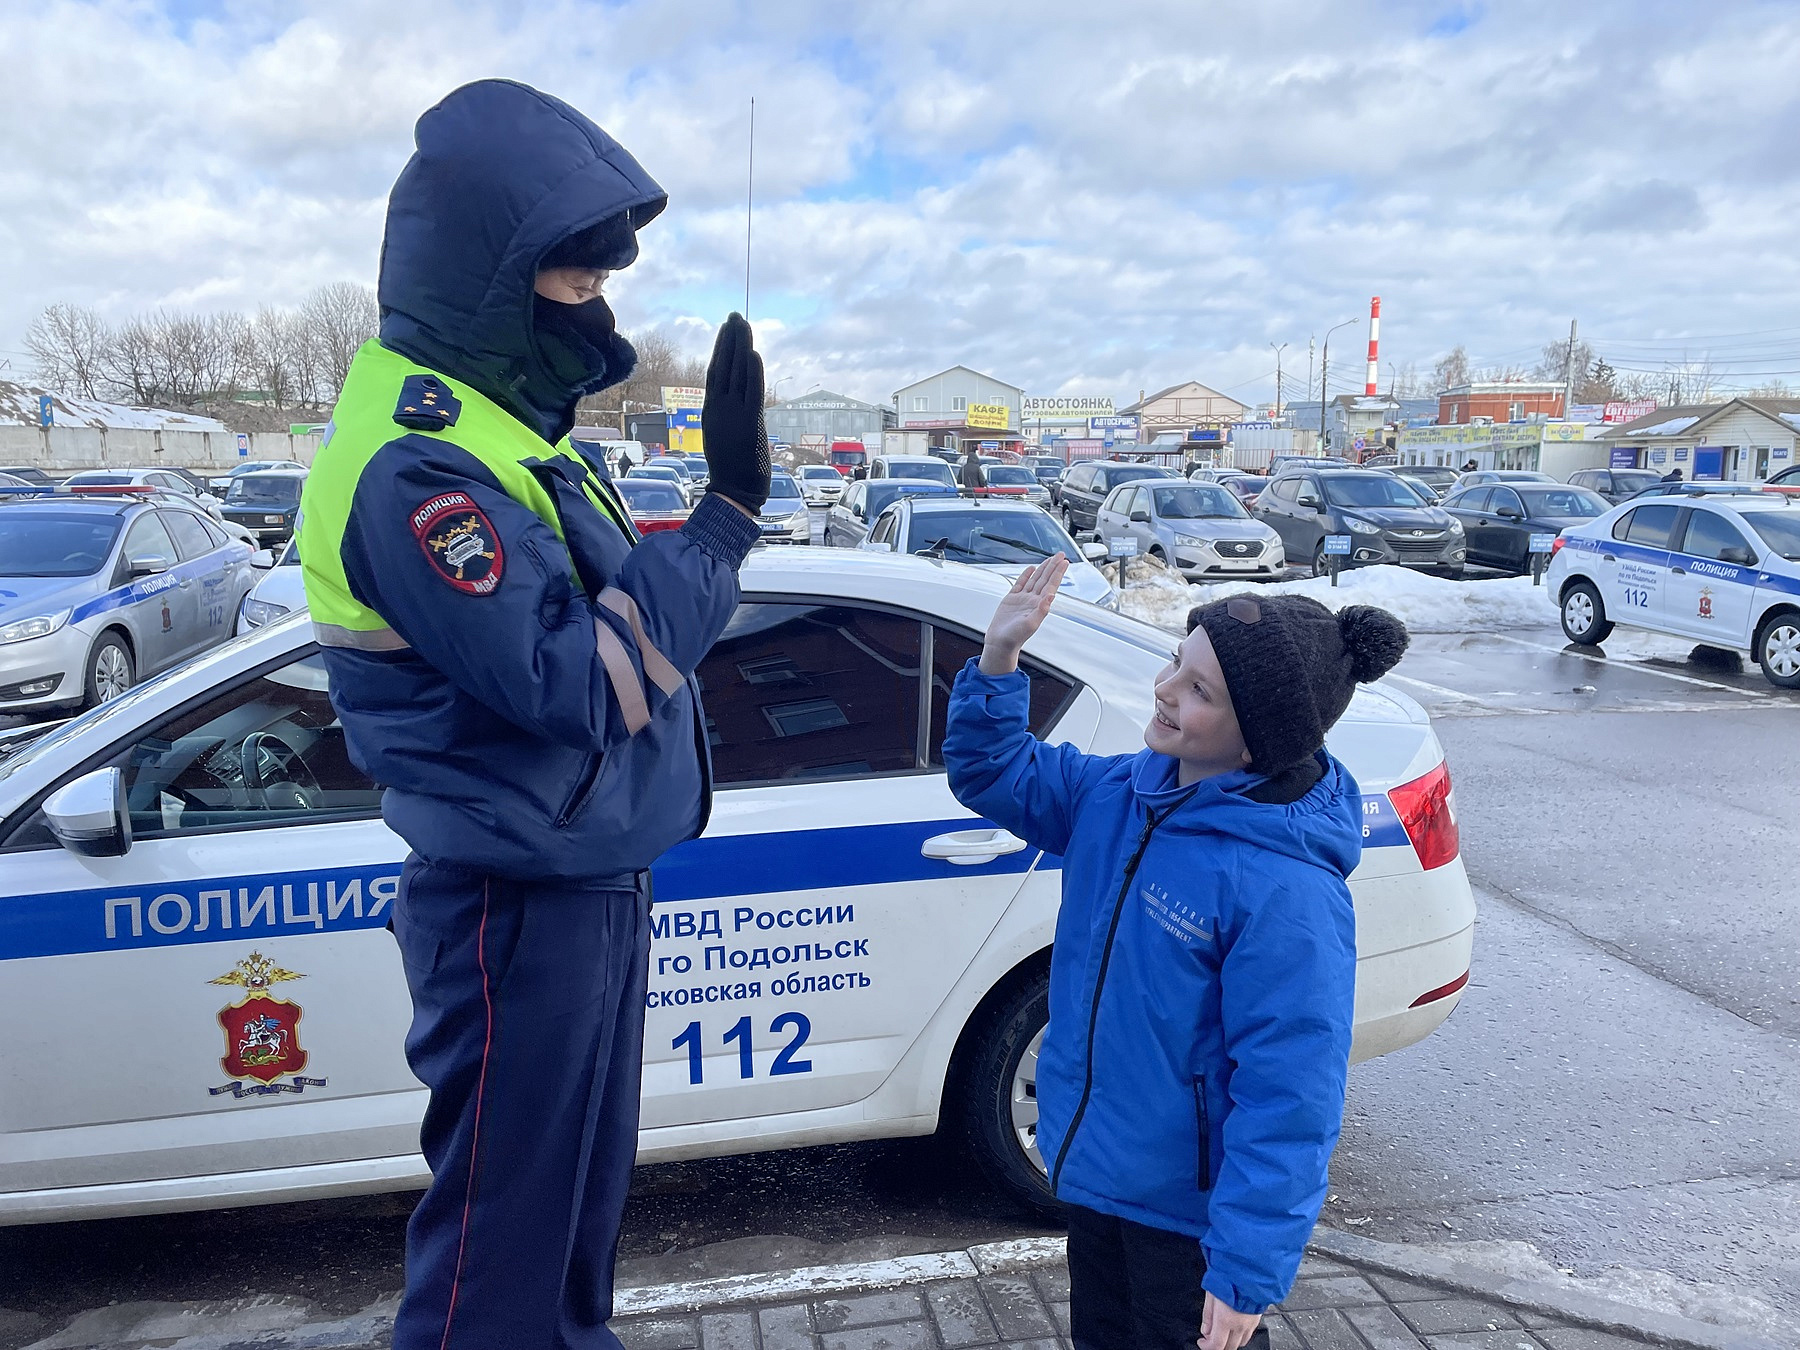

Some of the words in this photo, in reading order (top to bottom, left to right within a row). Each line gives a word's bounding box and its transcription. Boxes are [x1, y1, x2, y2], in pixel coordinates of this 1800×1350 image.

[974, 405, 1004, 415] КАФЕ
[1023, 398, 1113, 409] АВТОСТОЯНКА
[1606, 407, 1646, 416] ЕВГЕНИЯ
[1094, 418, 1136, 426] АВТОСЕРВИС
[414, 495, 467, 528] ПОЛИЦИЯ
[1690, 561, 1738, 578] ПОЛИЦИЯ
[141, 574, 177, 595] ПОЛИЦИЯ
[472, 572, 498, 592] МВД
[1624, 588, 1648, 608] 112
[208, 605, 223, 627] 112
[104, 875, 401, 939] ПОЛИЦИЯ
[1175, 901, 1205, 926] YORK
[734, 904, 854, 932] России
[658, 955, 692, 975] го
[704, 938, 869, 971] Подольск
[646, 981, 761, 1008] сковская
[771, 971, 871, 997] область
[672, 1011, 813, 1085] 112
